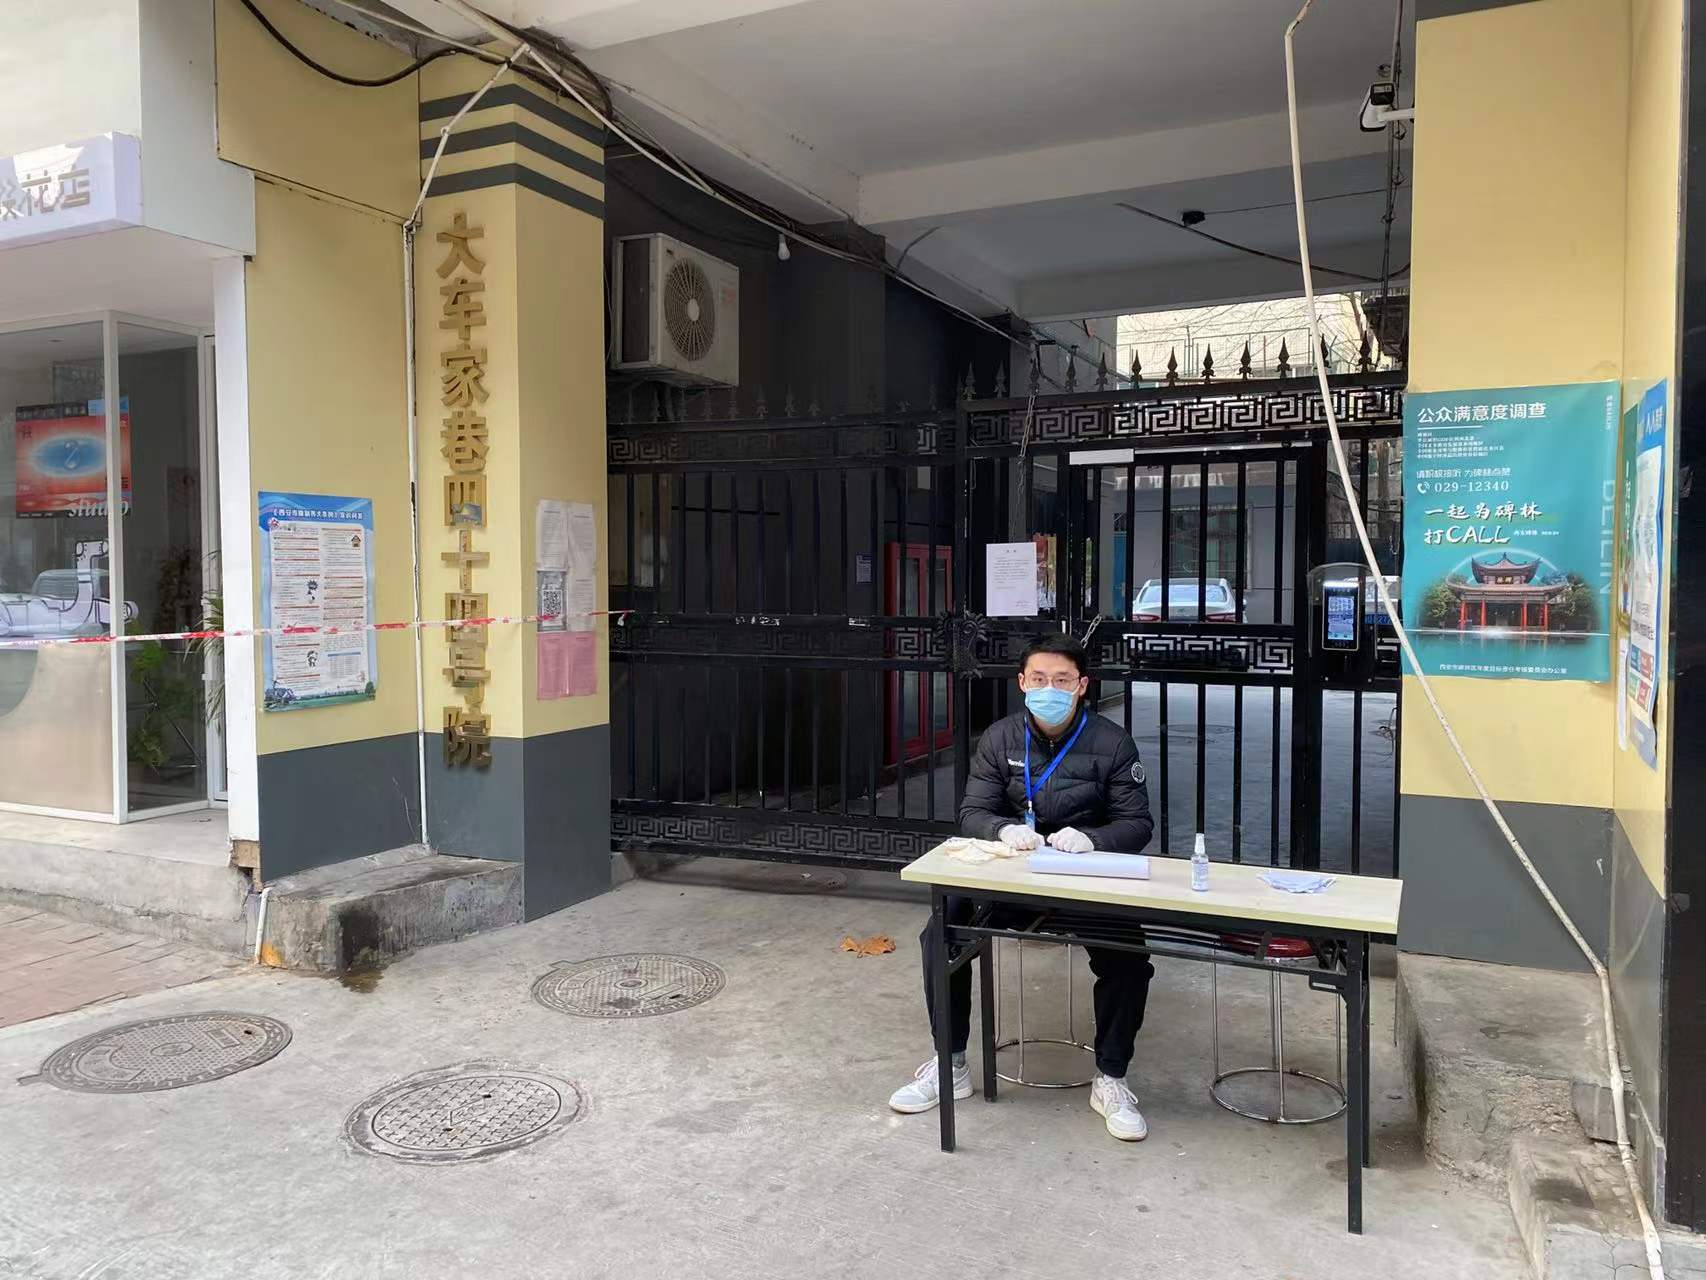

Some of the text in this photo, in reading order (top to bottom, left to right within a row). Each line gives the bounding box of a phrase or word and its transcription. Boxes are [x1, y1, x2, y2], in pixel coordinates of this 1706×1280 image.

[1417, 402, 1547, 424] 公众满意度调查
[1434, 480, 1509, 493] 029-12340
[1424, 501, 1543, 522] 一起为碑林
[1424, 525, 1511, 545] 打CALL
